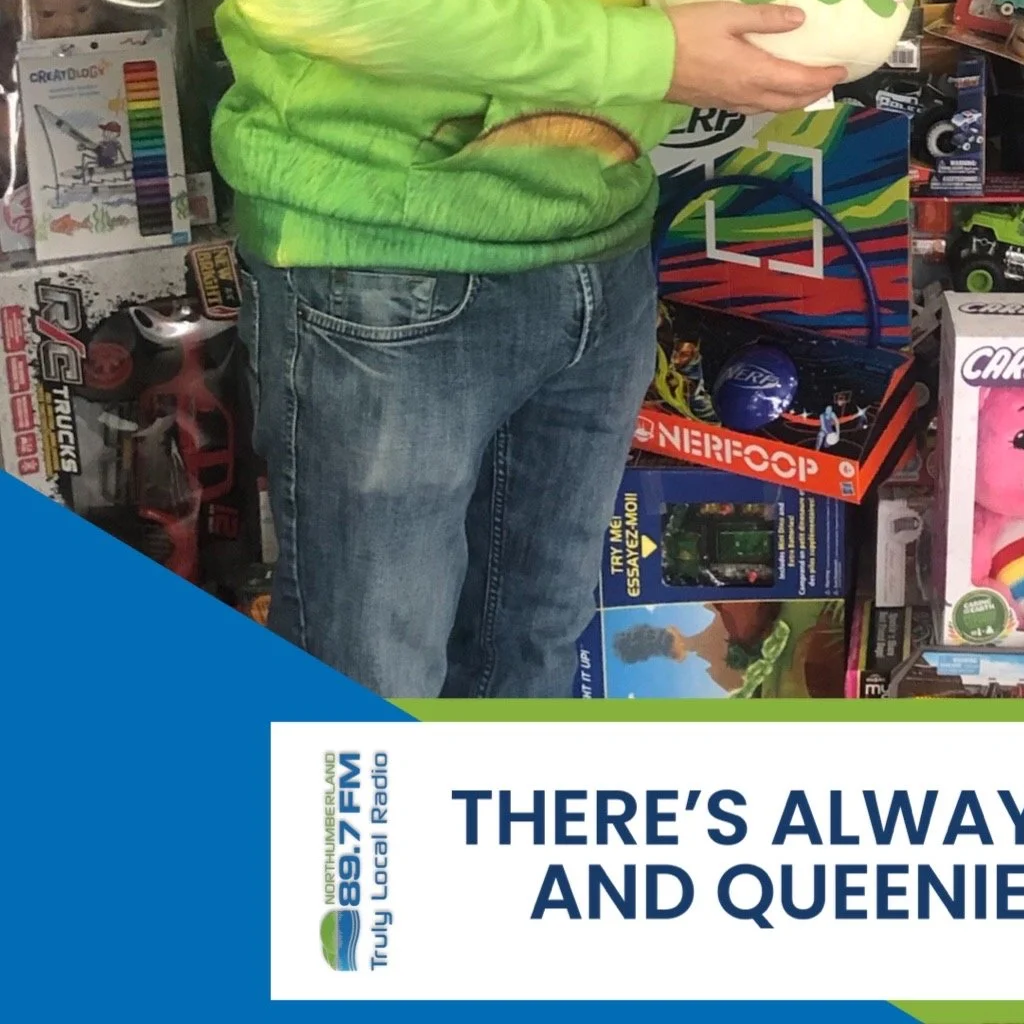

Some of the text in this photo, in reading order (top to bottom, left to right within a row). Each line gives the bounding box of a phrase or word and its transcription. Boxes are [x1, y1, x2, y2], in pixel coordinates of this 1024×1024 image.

[52, 385, 79, 474] TRUCKS
[657, 421, 819, 483] NERFOOP
[611, 550, 623, 575] TRY
